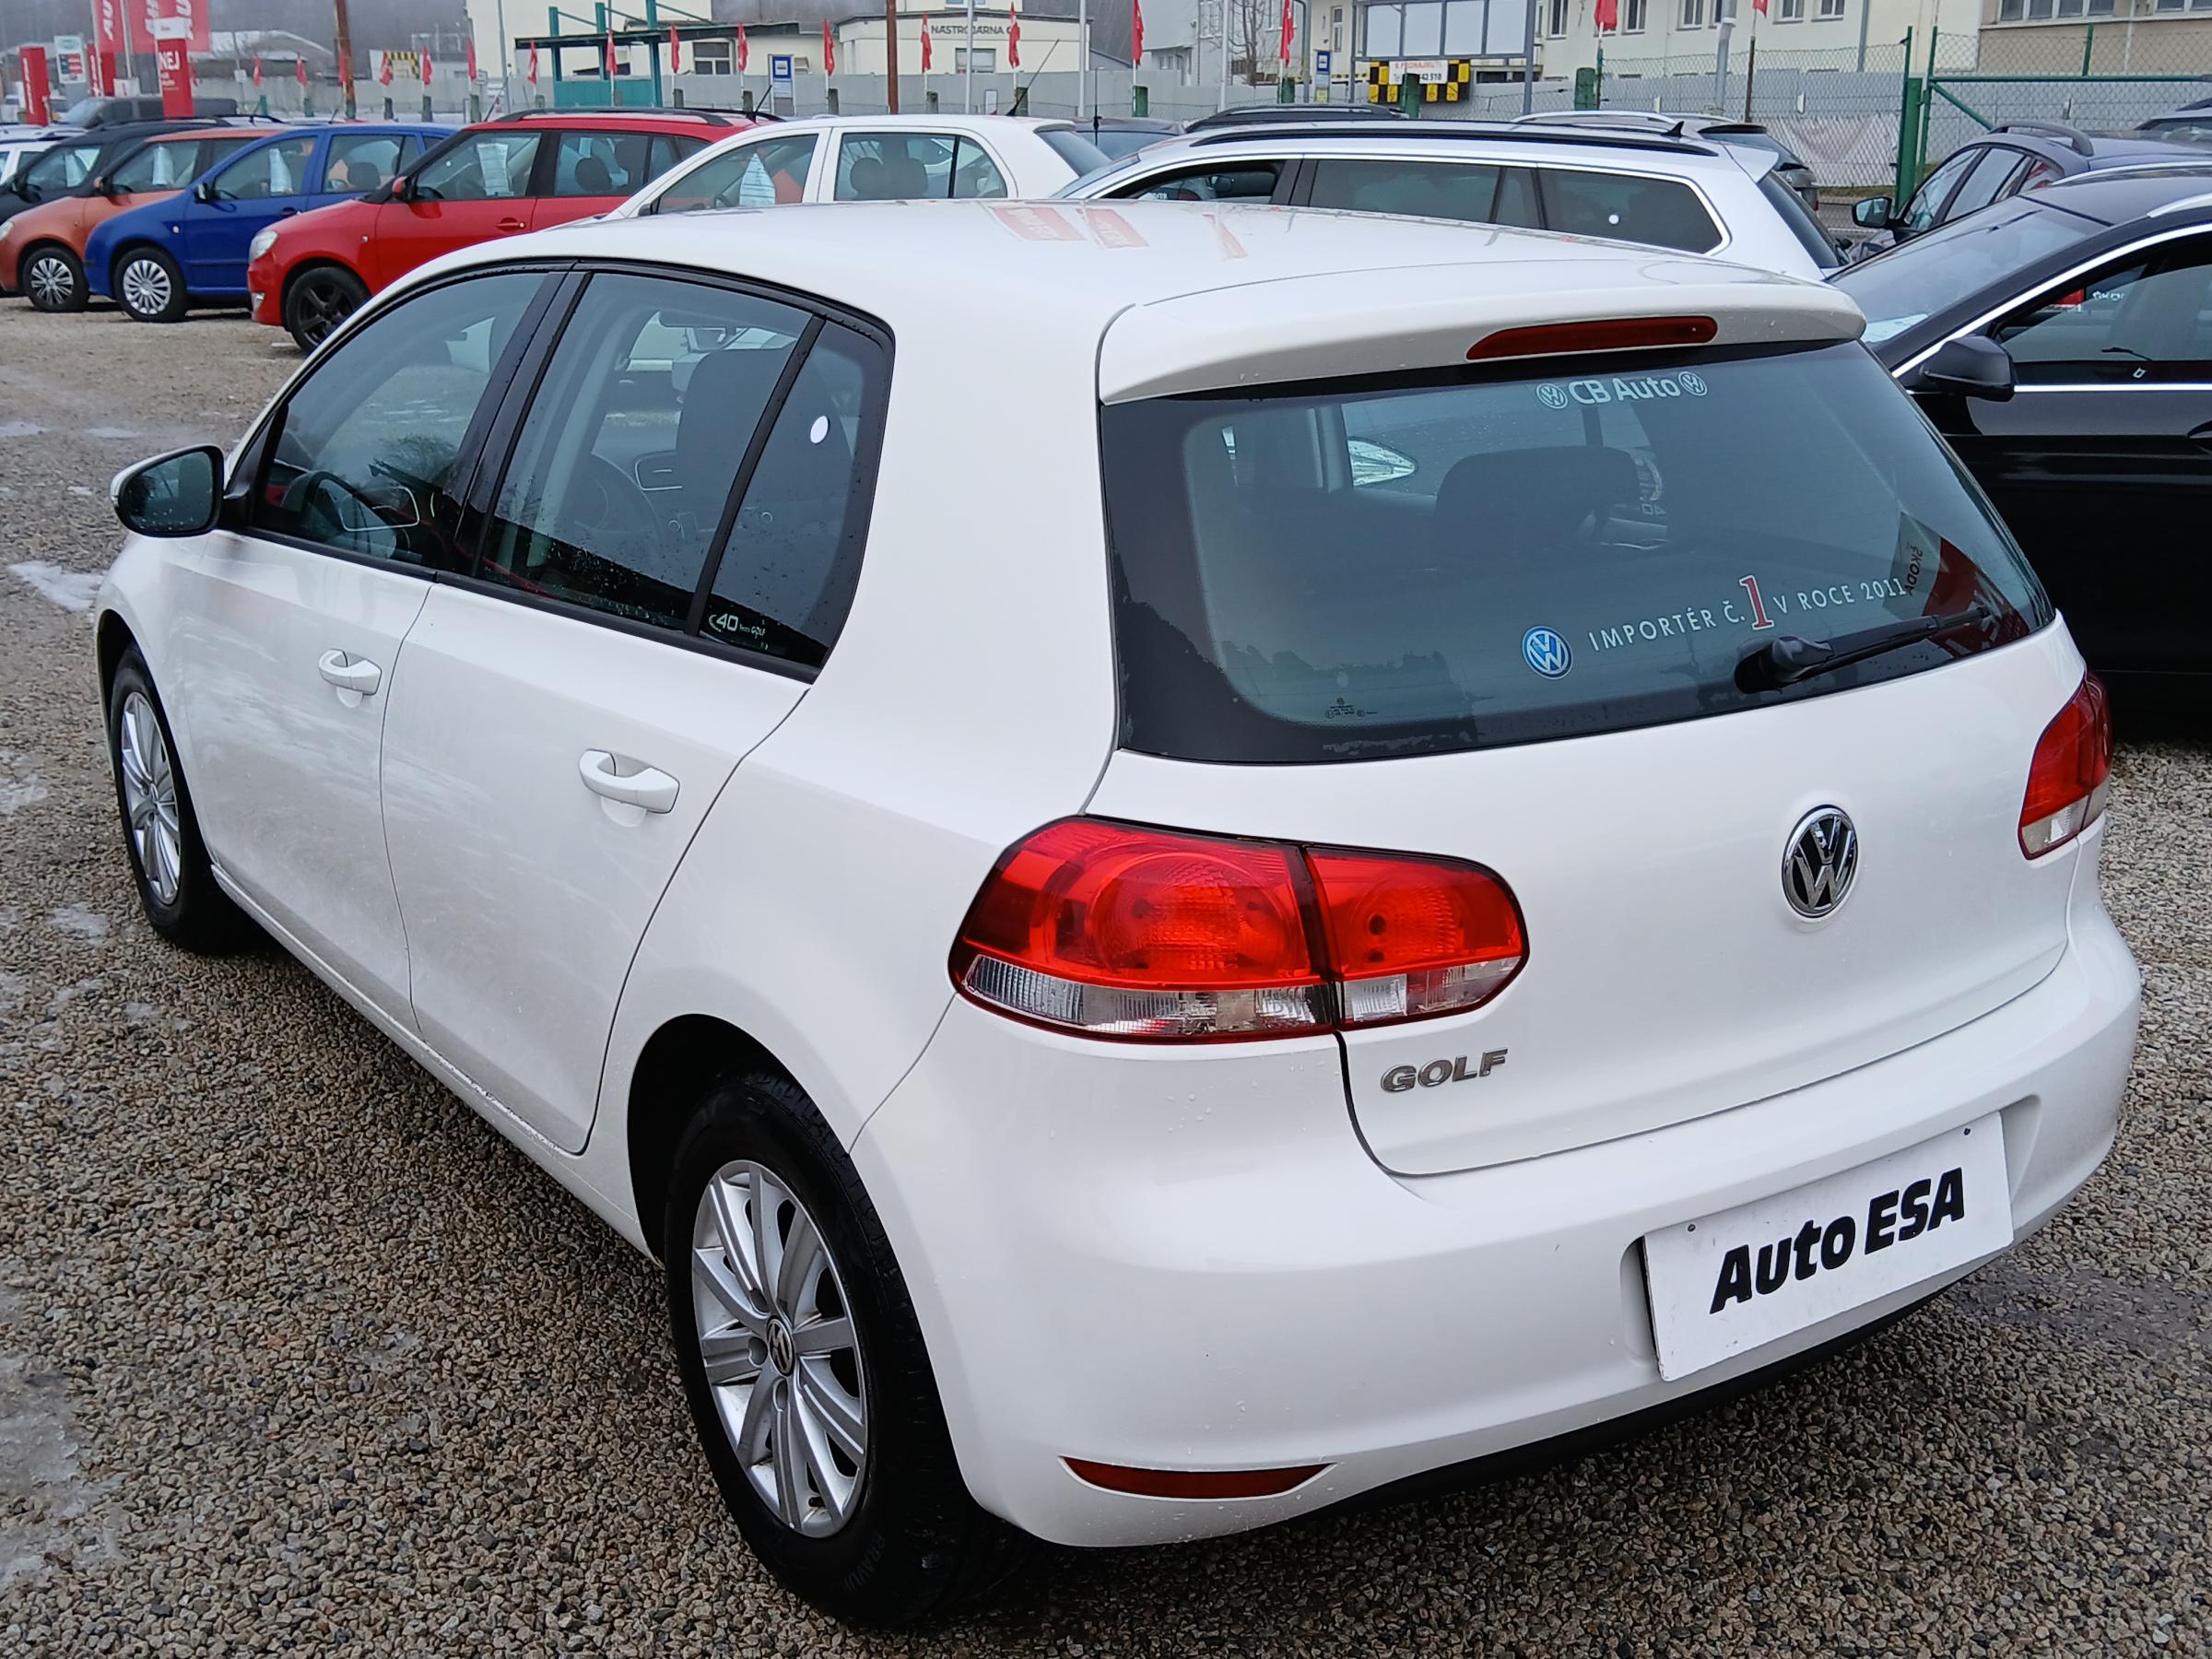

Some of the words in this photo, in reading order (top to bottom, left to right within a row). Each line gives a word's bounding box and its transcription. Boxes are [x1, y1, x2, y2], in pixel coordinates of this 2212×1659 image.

[1568, 380, 1612, 404] CB
[1612, 376, 1681, 401] Auto
[1589, 606, 1717, 651] IMPORTÉR
[1739, 574, 1775, 630] 1
[1772, 594, 1788, 614] V
[1797, 585, 1855, 610] ROCE
[1860, 578, 1907, 600] 2011
[1381, 1047, 1509, 1093] GOLF
[1709, 1216, 1856, 1315] Auto
[1864, 1167, 1965, 1255] ESA
